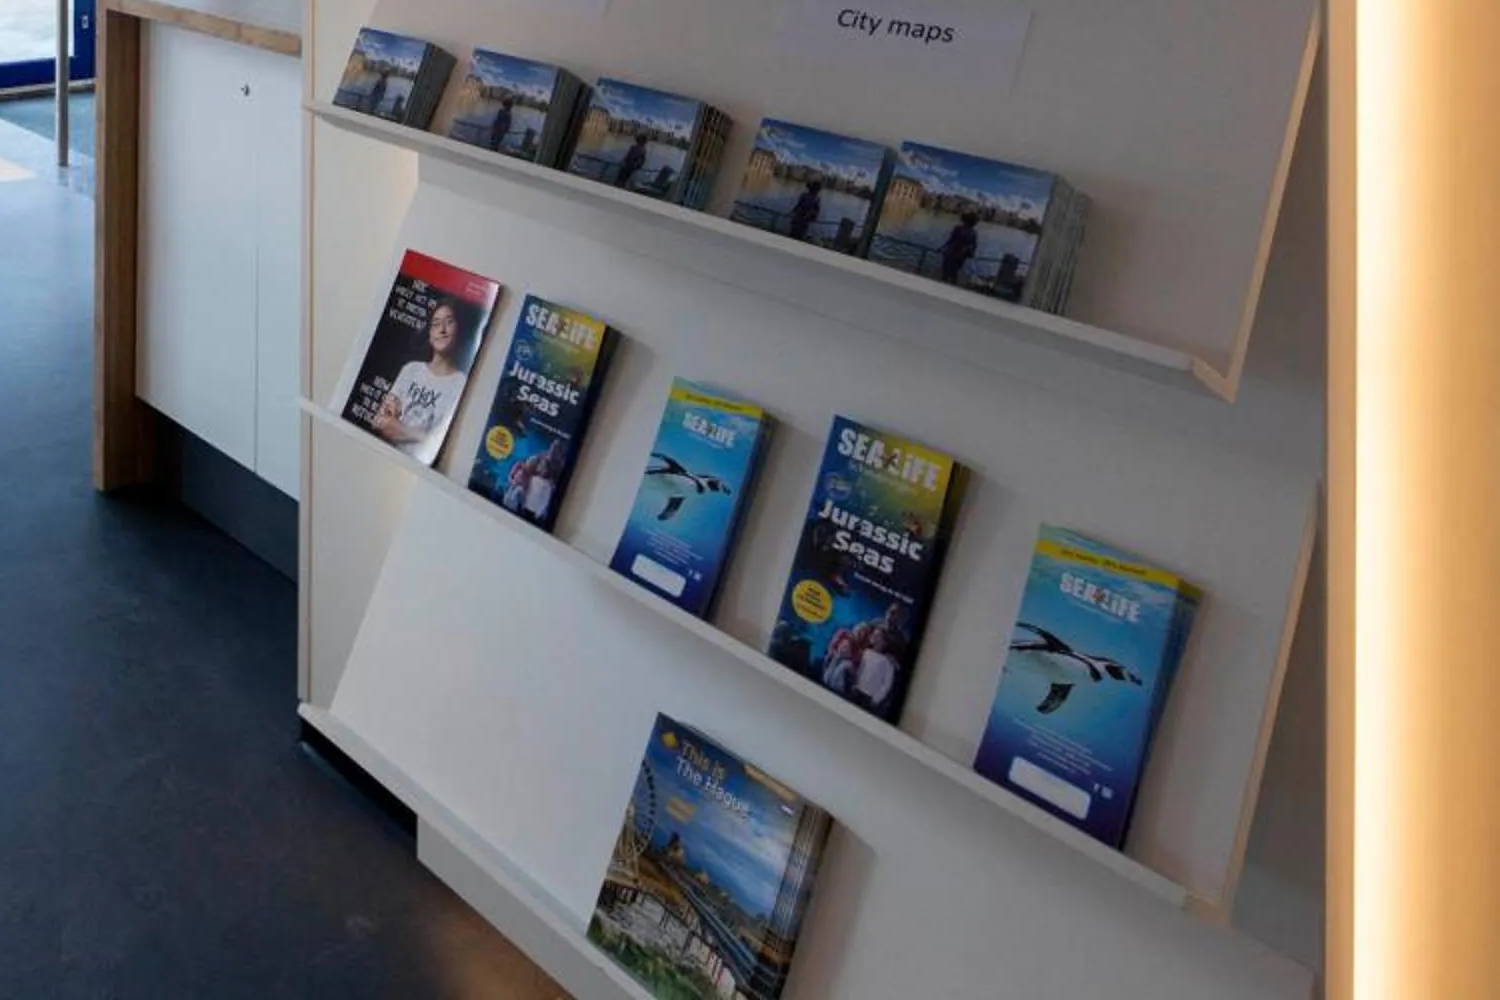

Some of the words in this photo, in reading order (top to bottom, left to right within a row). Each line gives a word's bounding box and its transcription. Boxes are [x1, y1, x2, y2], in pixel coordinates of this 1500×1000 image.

[837, 8, 883, 37] City
[887, 19, 955, 45] maps
[525, 303, 561, 338] SEA
[509, 360, 580, 406] Jurassic
[516, 385, 561, 417] Seas
[682, 411, 708, 437] SEA
[837, 427, 886, 470] SEA
[818, 499, 924, 562] Jurassic
[832, 530, 896, 575] Seas
[1059, 570, 1097, 604] SEA
[682, 739, 711, 772] This
[711, 759, 726, 781] is
[675, 754, 703, 787] The
[704, 775, 751, 816] Hague
